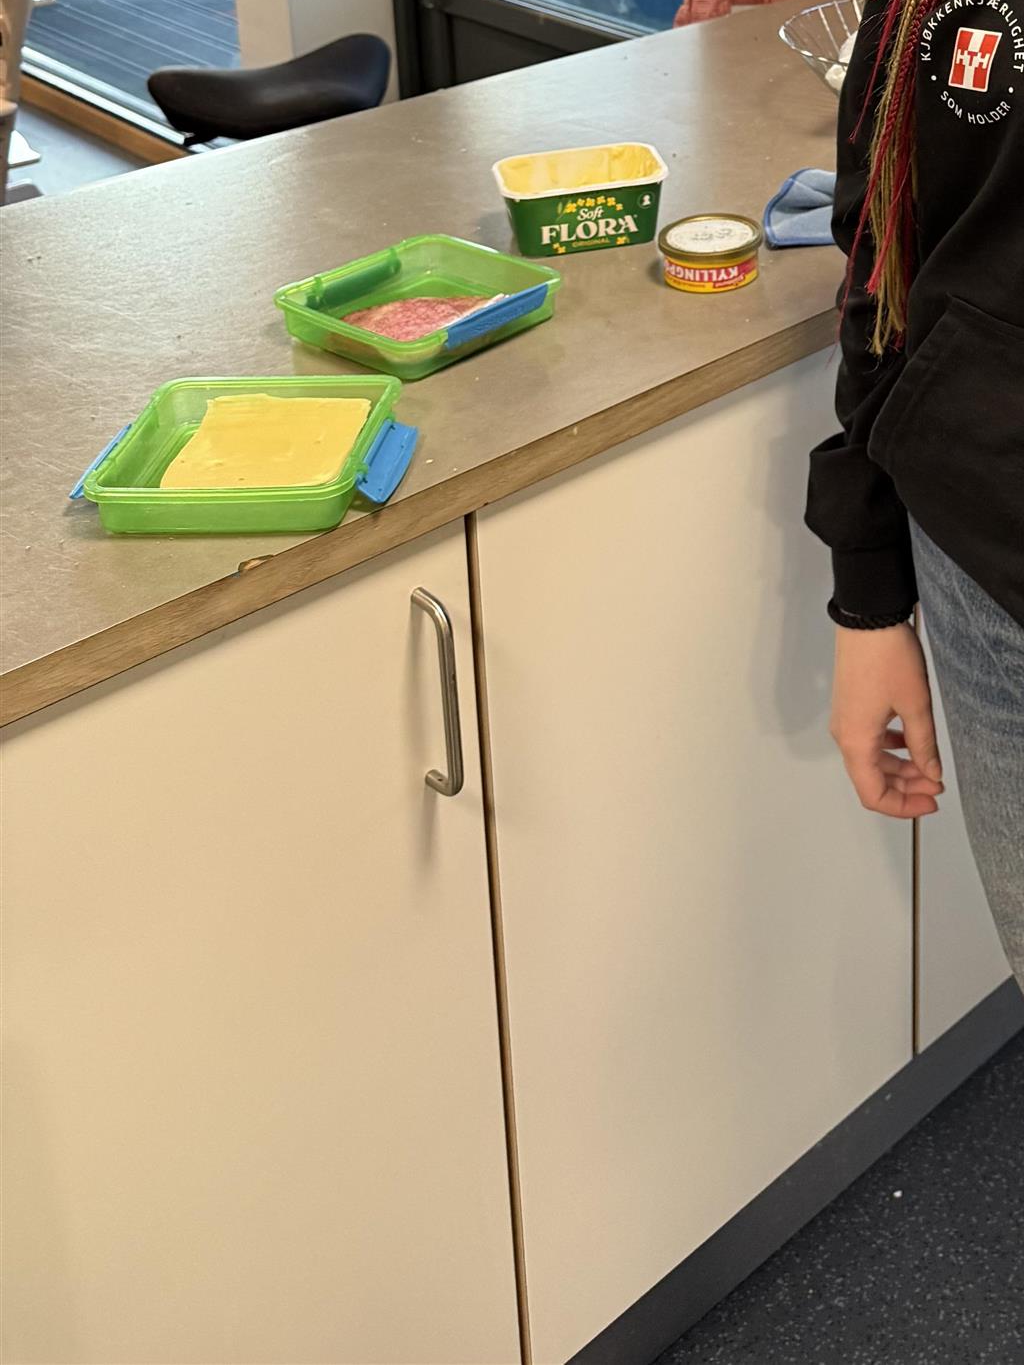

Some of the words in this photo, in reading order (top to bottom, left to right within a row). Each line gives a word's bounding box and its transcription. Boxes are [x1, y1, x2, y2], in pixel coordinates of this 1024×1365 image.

[956, 49, 991, 69] HTH
[940, 90, 963, 119] SOM
[967, 101, 1011, 125] HOLDER
[577, 205, 604, 221] Soft
[540, 214, 639, 245] FLORA
